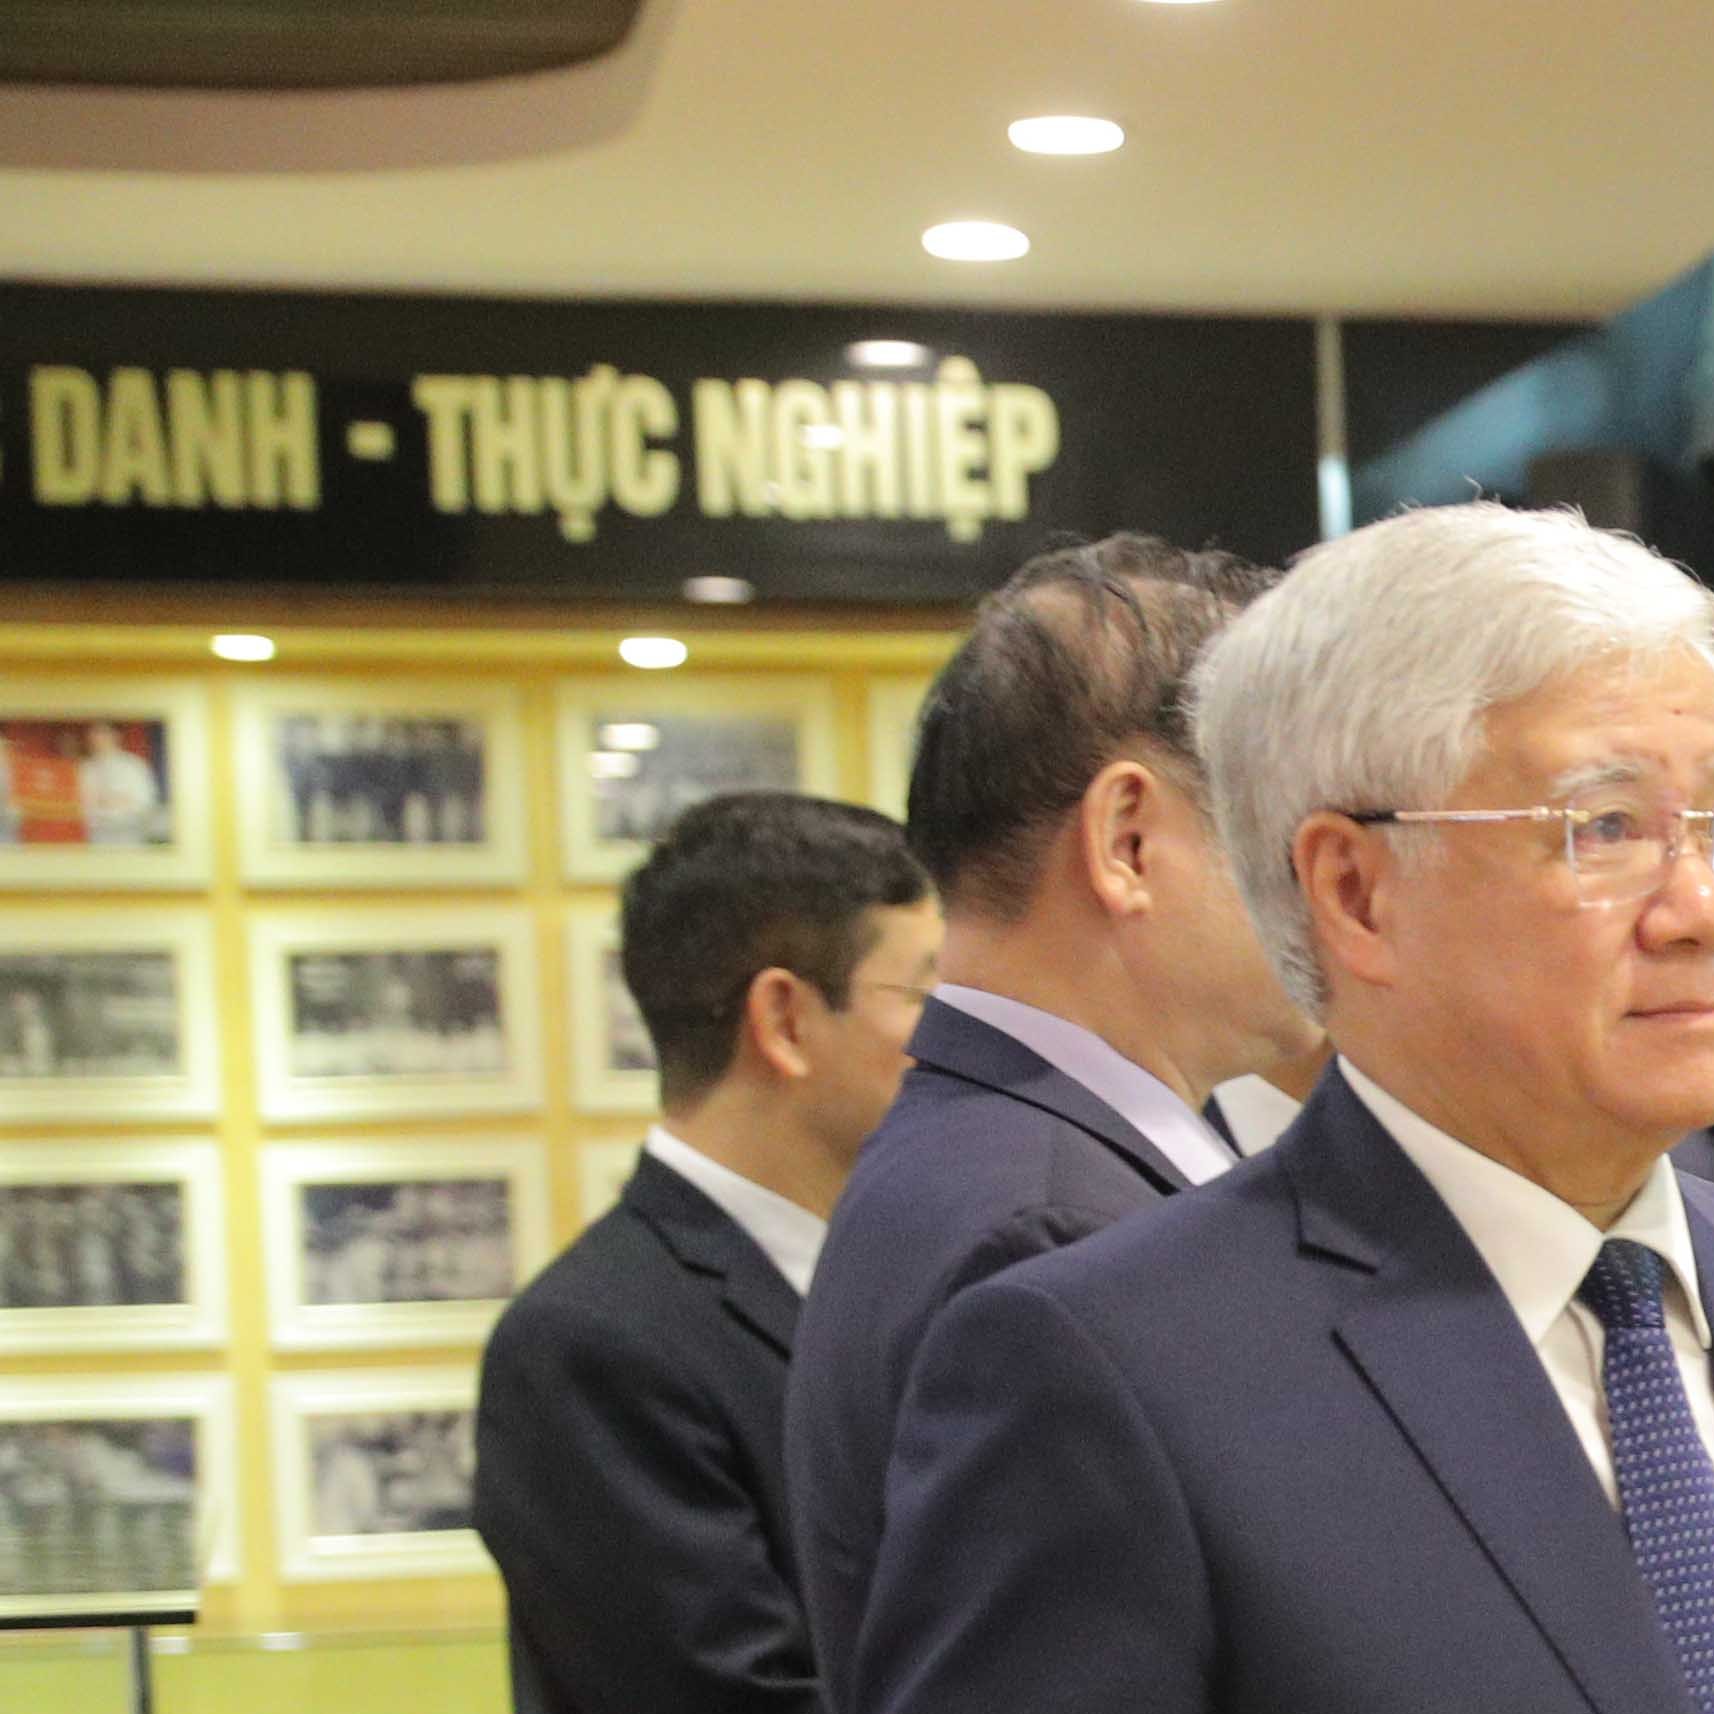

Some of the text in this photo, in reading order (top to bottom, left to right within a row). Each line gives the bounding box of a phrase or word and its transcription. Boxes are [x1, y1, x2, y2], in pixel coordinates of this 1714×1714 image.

[29, 364, 319, 510] DANH
[411, 362, 680, 543] THỰC
[692, 354, 1060, 543] NGHIỆP
